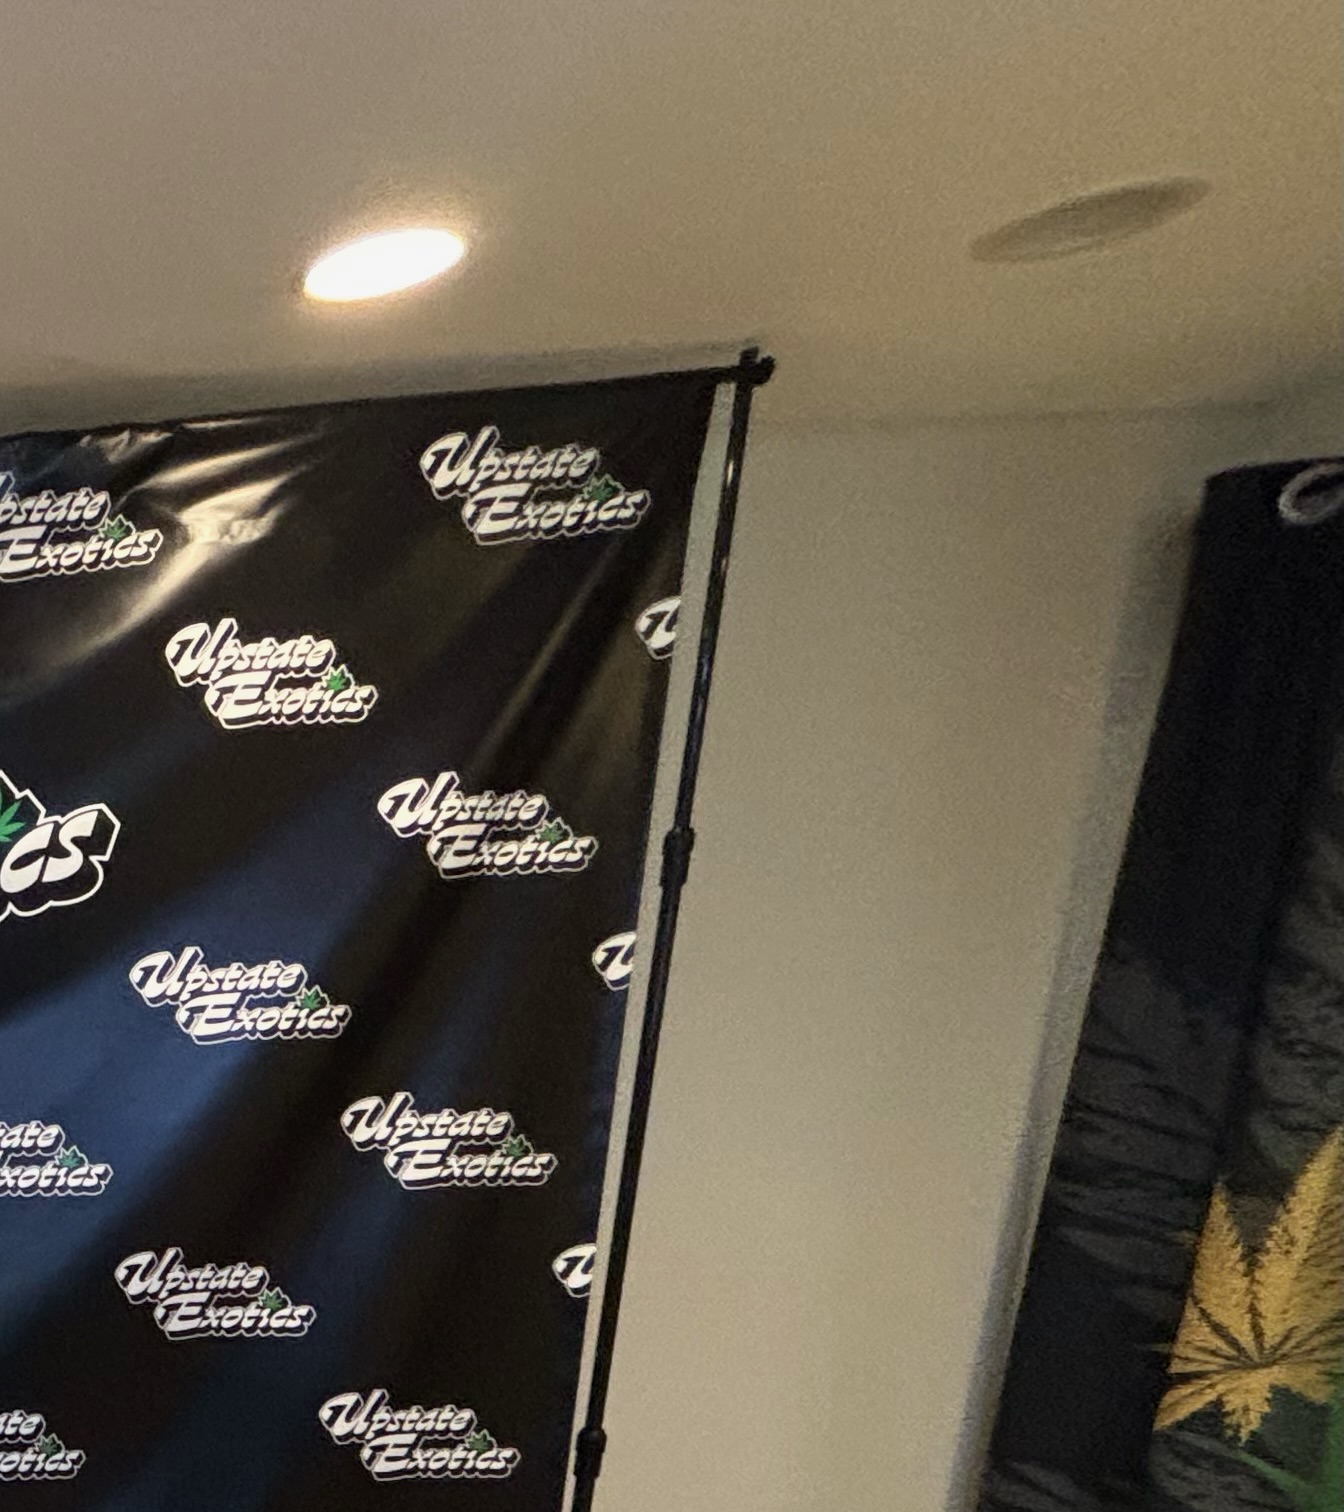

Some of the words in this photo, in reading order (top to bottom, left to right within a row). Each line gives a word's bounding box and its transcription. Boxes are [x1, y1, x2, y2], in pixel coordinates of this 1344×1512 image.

[422, 427, 599, 497] Upstate
[467, 483, 648, 542] Exotics
[167, 619, 331, 683] Upstate
[209, 671, 376, 726] Exotics
[379, 772, 549, 835] Upstate
[422, 822, 596, 876] Exotics
[130, 947, 303, 1004] Upstate
[174, 993, 350, 1042] Exotics
[342, 1092, 510, 1149] Upstate
[385, 1138, 556, 1186] Exotics
[117, 1247, 273, 1302] Upstate
[156, 1291, 315, 1338] Exotics
[320, 1390, 476, 1443] Upstate
[360, 1433, 519, 1478] Exotics
